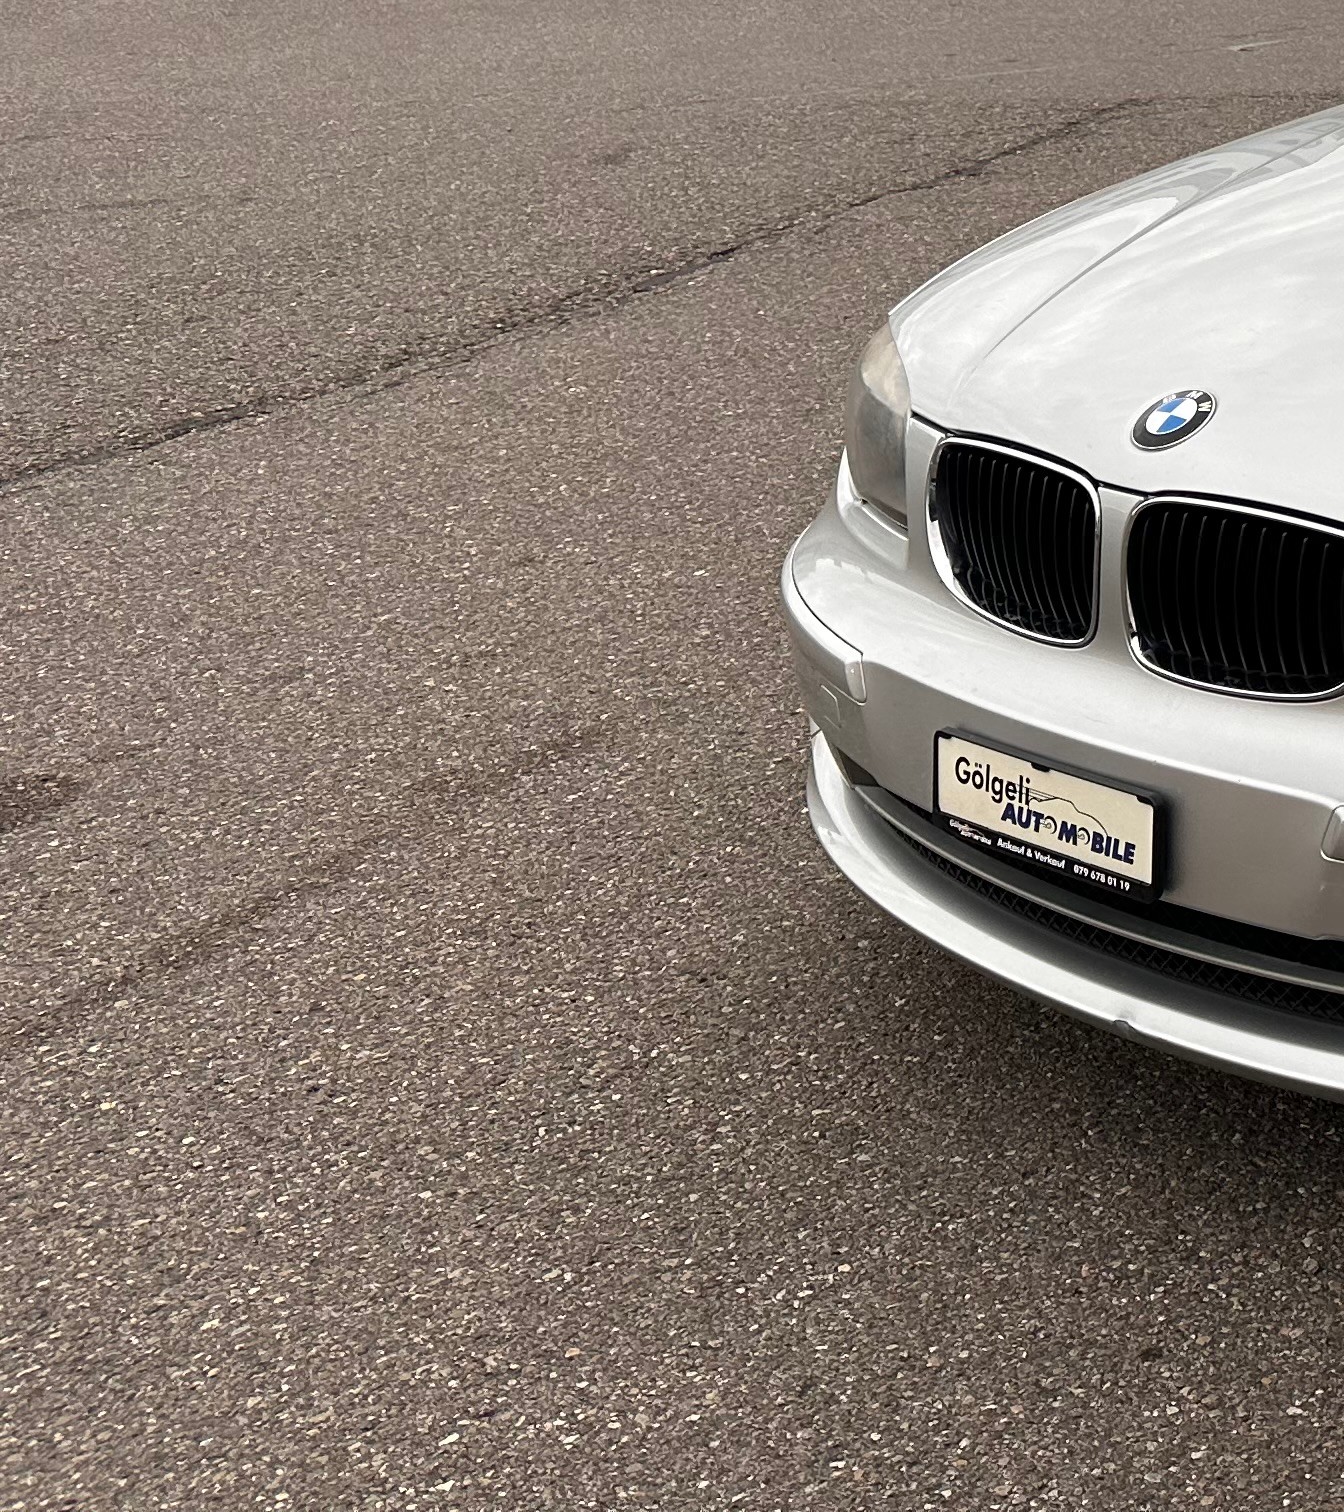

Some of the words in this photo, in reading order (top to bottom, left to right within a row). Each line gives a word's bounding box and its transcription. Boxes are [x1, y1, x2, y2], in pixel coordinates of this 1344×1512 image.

[955, 756, 1031, 805] Gölgeli
[997, 838, 1025, 855] Ankauf
[1026, 848, 1033, 858] &
[1034, 850, 1066, 869] Verkauf
[1073, 864, 1089, 877] 079
